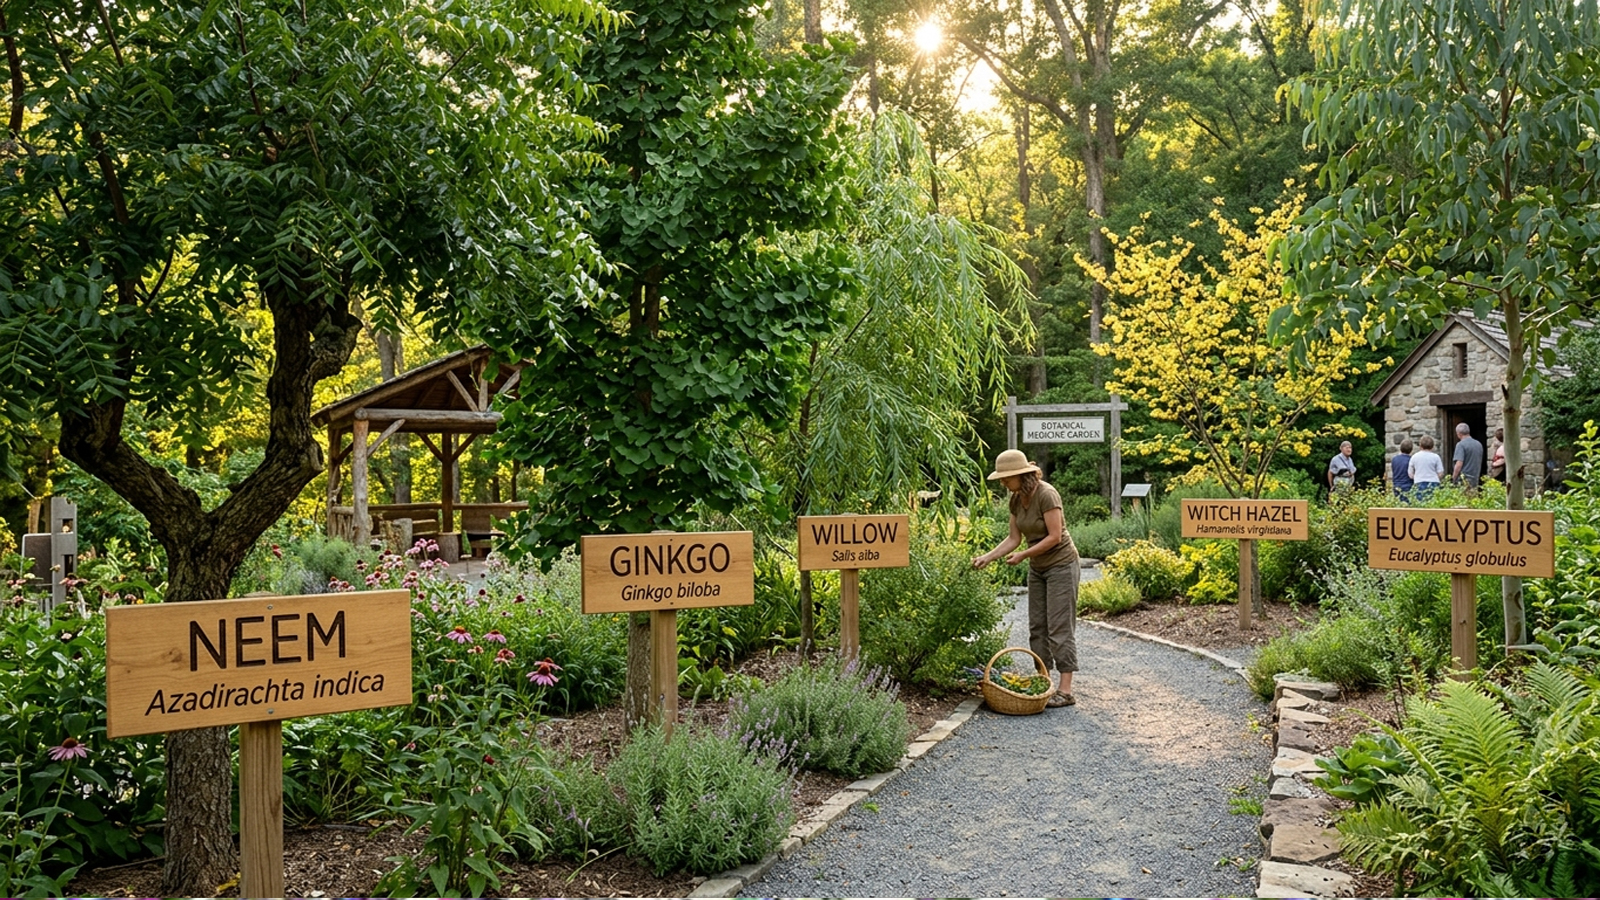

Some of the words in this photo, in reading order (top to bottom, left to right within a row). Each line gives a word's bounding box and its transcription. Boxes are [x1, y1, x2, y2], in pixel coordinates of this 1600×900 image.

[1187, 505, 1241, 521] WITCH
[1246, 505, 1302, 522] HAZEL
[811, 522, 898, 545] WILLOW
[1376, 516, 1542, 546] EUCALYPTUS
[610, 542, 730, 577] GINKGO
[1388, 547, 1462, 566] Eucalyptus
[1465, 550, 1528, 567] globulus
[621, 583, 673, 603] Ginkgo
[677, 581, 721, 599] biloba
[189, 610, 346, 672] NEEM
[144, 678, 305, 717] Azadirachta
[312, 670, 385, 699] indica
